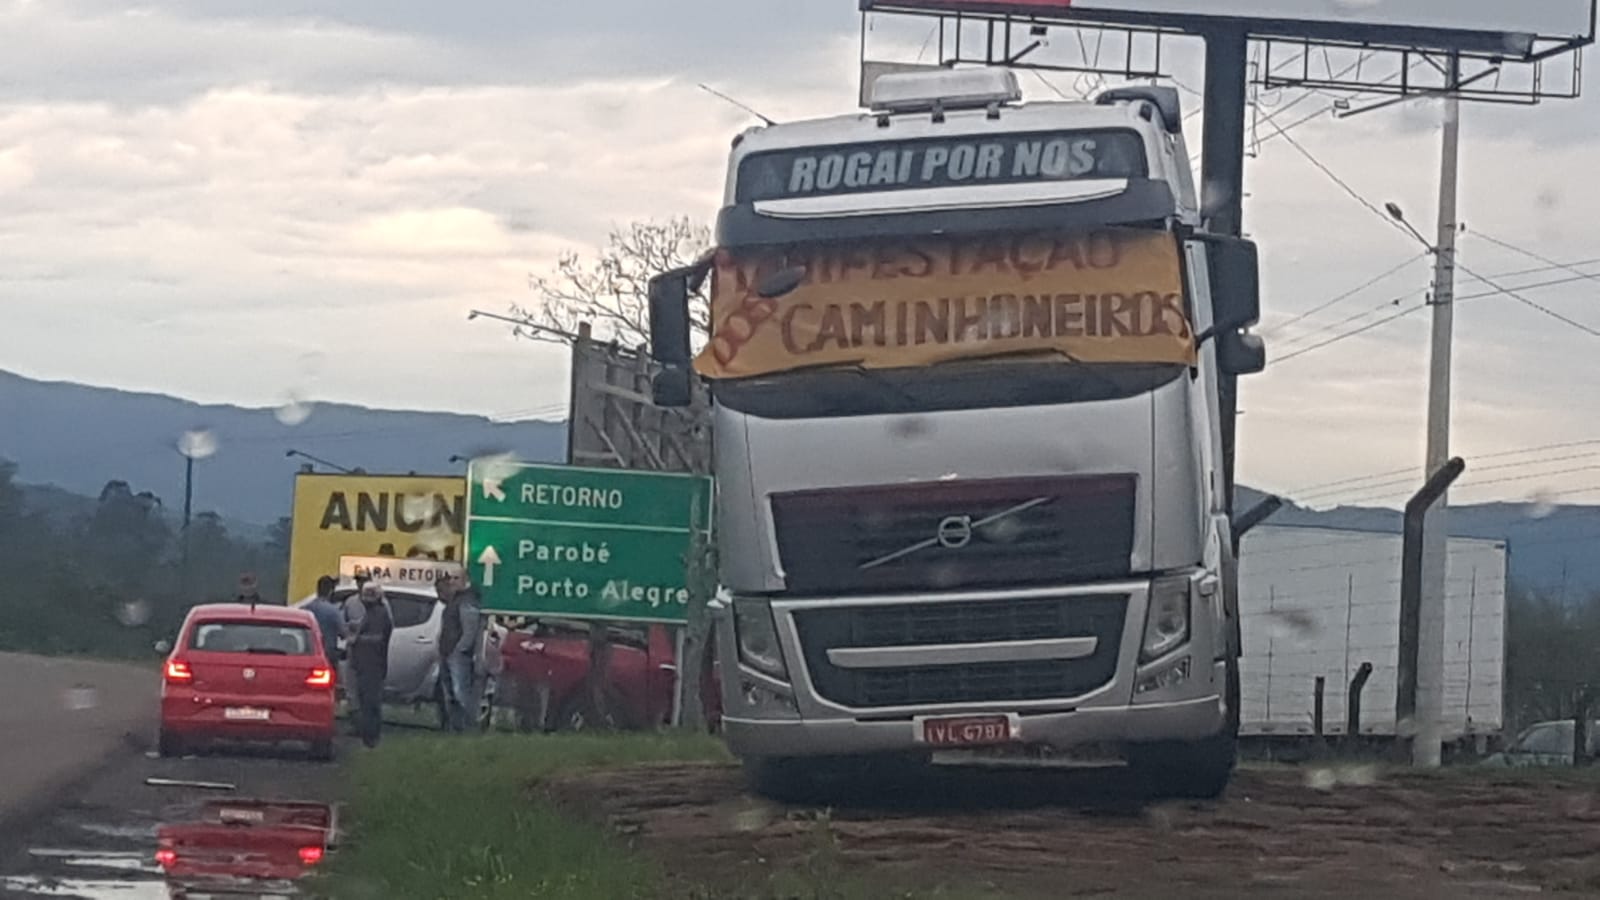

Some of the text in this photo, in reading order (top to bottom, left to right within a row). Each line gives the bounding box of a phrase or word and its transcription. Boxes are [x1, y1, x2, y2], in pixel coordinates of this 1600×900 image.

[788, 150, 913, 193] ROGAI
[922, 142, 1004, 181] POR
[781, 290, 1190, 354] CAMINHONEIROS
[520, 482, 623, 509] RETORNO
[518, 539, 611, 564] Parobé
[518, 575, 690, 607] Porto Alegre
